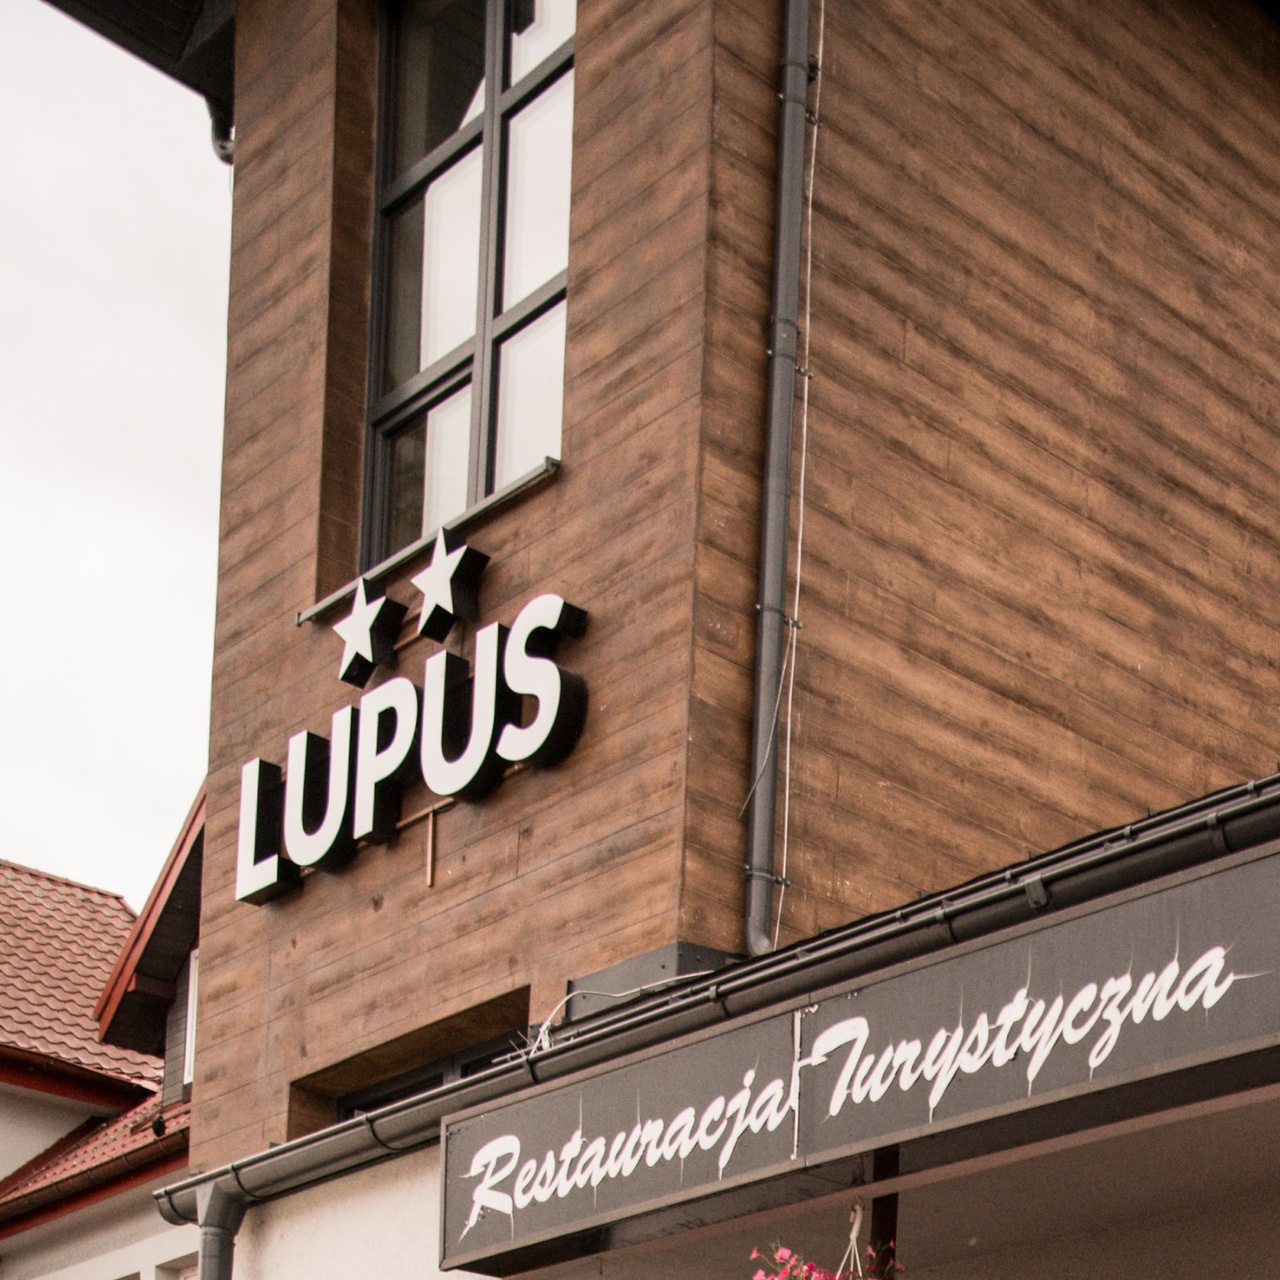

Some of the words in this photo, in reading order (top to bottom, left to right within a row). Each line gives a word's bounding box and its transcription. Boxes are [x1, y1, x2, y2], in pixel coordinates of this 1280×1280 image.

[235, 593, 567, 902] LUPUS
[459, 1068, 796, 1242] Restauracja
[806, 944, 1240, 1120] Turystyczna
